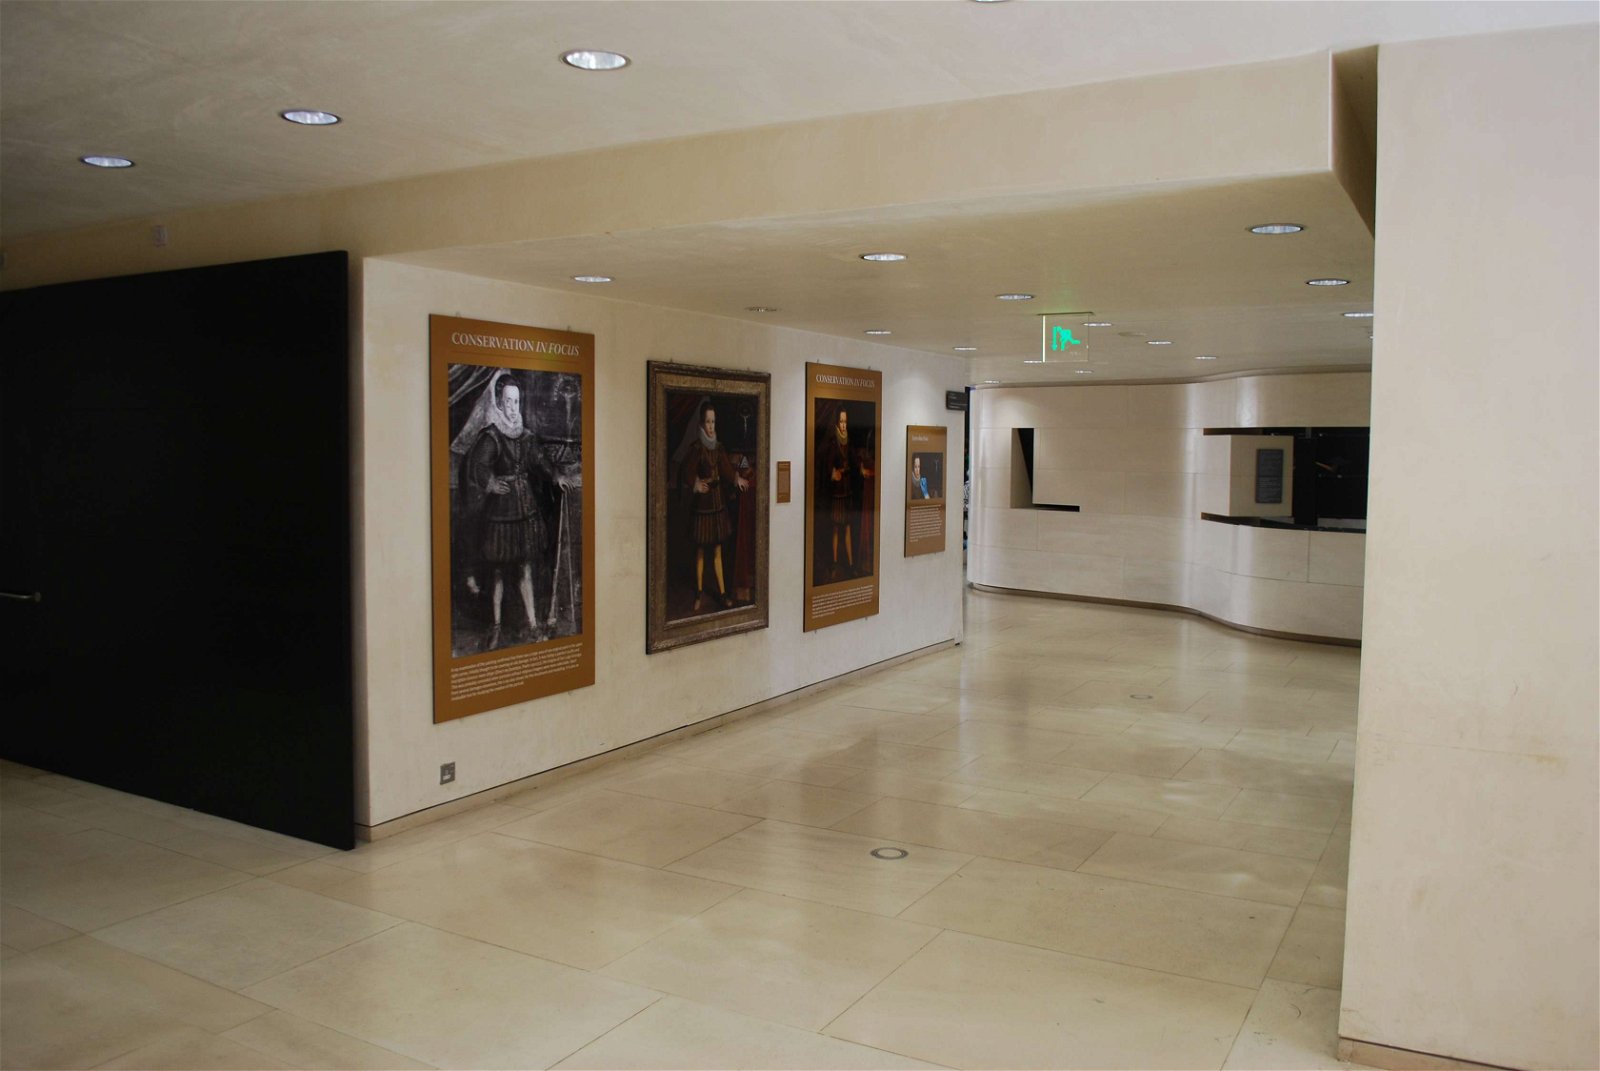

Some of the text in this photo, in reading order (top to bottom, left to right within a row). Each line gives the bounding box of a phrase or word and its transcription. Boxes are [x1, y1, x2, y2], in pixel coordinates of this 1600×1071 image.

[451, 332, 580, 356] CONSERVATION IN FOCUS
[816, 374, 853, 386] CONSERVATION
